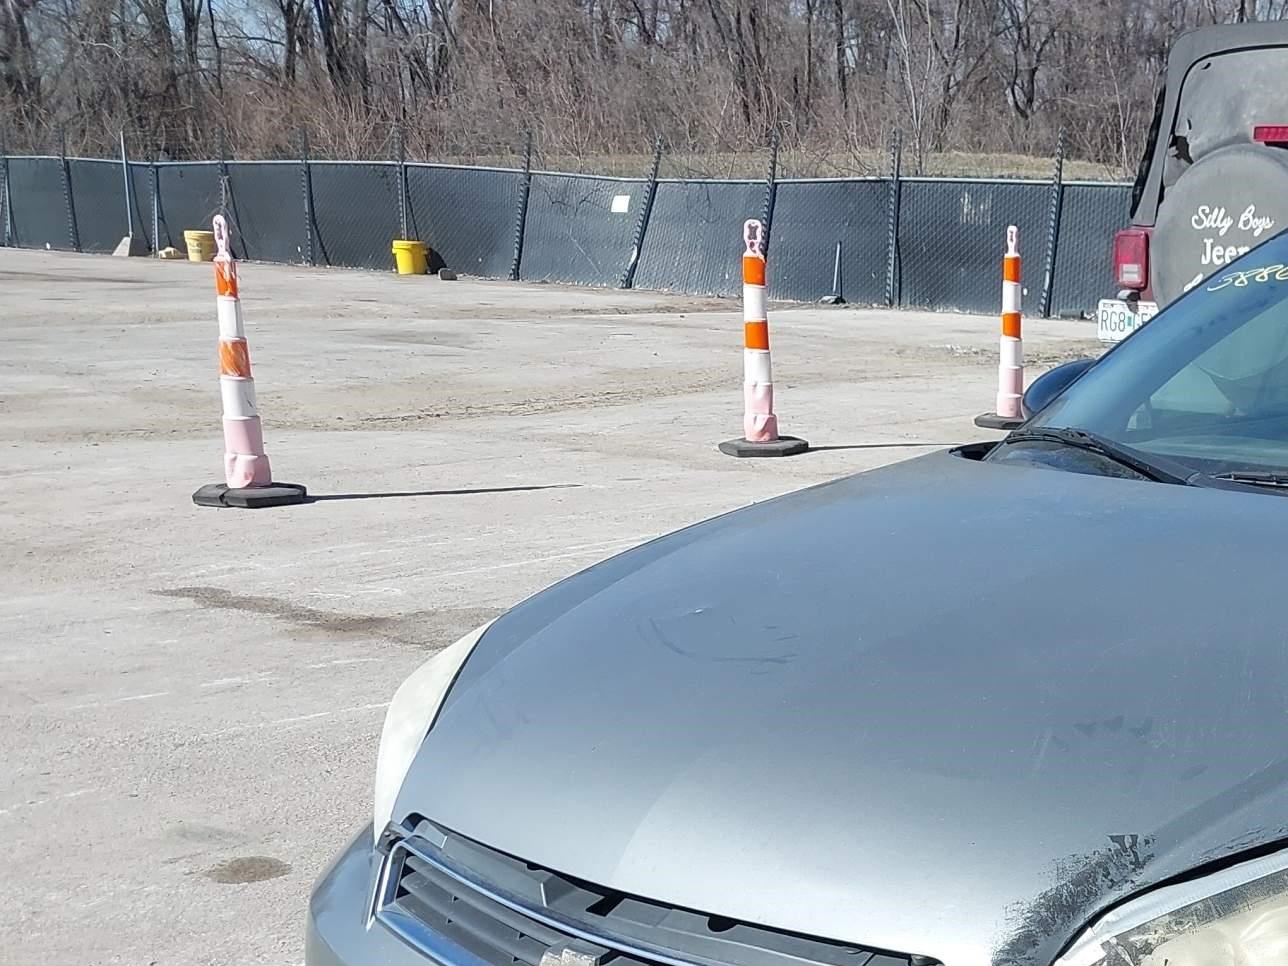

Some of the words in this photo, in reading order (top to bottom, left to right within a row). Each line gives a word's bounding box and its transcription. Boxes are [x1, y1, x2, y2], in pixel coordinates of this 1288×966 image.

[1191, 205, 1233, 236] Silly
[1238, 204, 1274, 237] Boys
[1100, 309, 1126, 333] RG8
